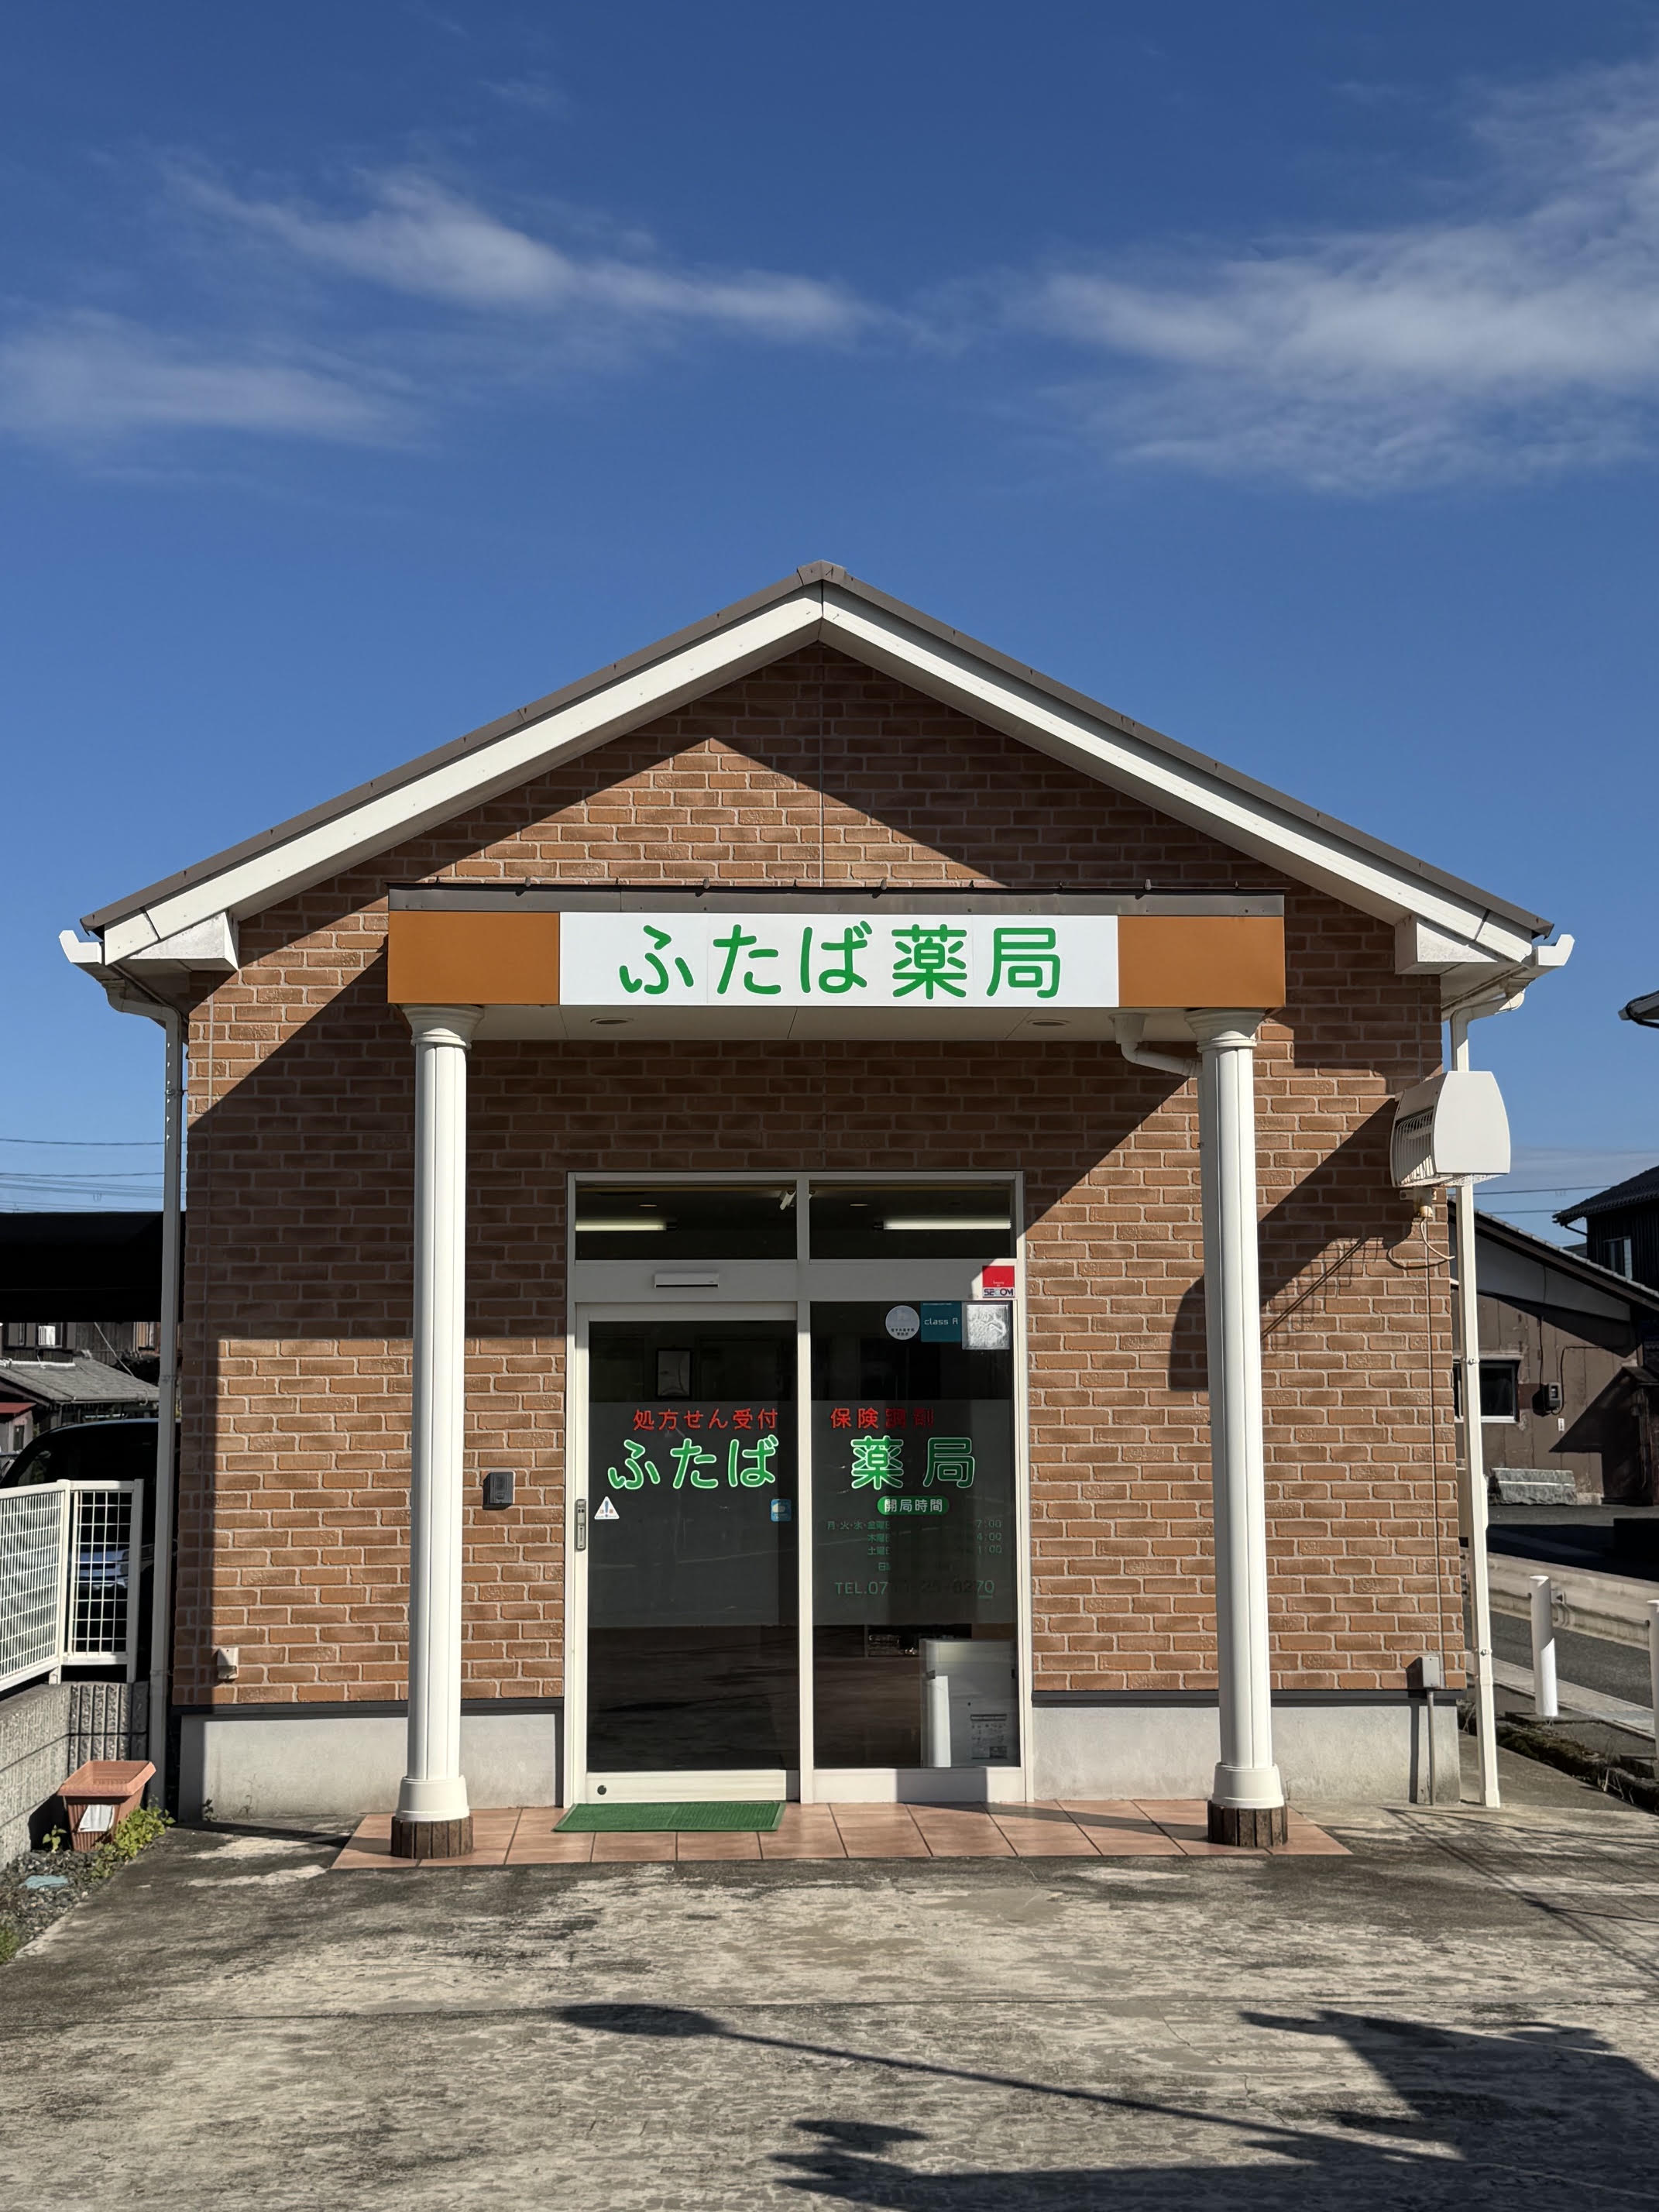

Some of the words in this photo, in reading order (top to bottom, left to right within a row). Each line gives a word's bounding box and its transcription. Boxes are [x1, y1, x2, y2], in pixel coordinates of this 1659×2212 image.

[619, 920, 1061, 1000] ふたば薬局
[984, 1288, 1014, 1297] SECOM
[633, 1408, 778, 1431] 処方せん受付
[607, 1434, 779, 1490] ふたば
[850, 1434, 976, 1491] 薬局
[884, 1498, 943, 1513] 開局時間
